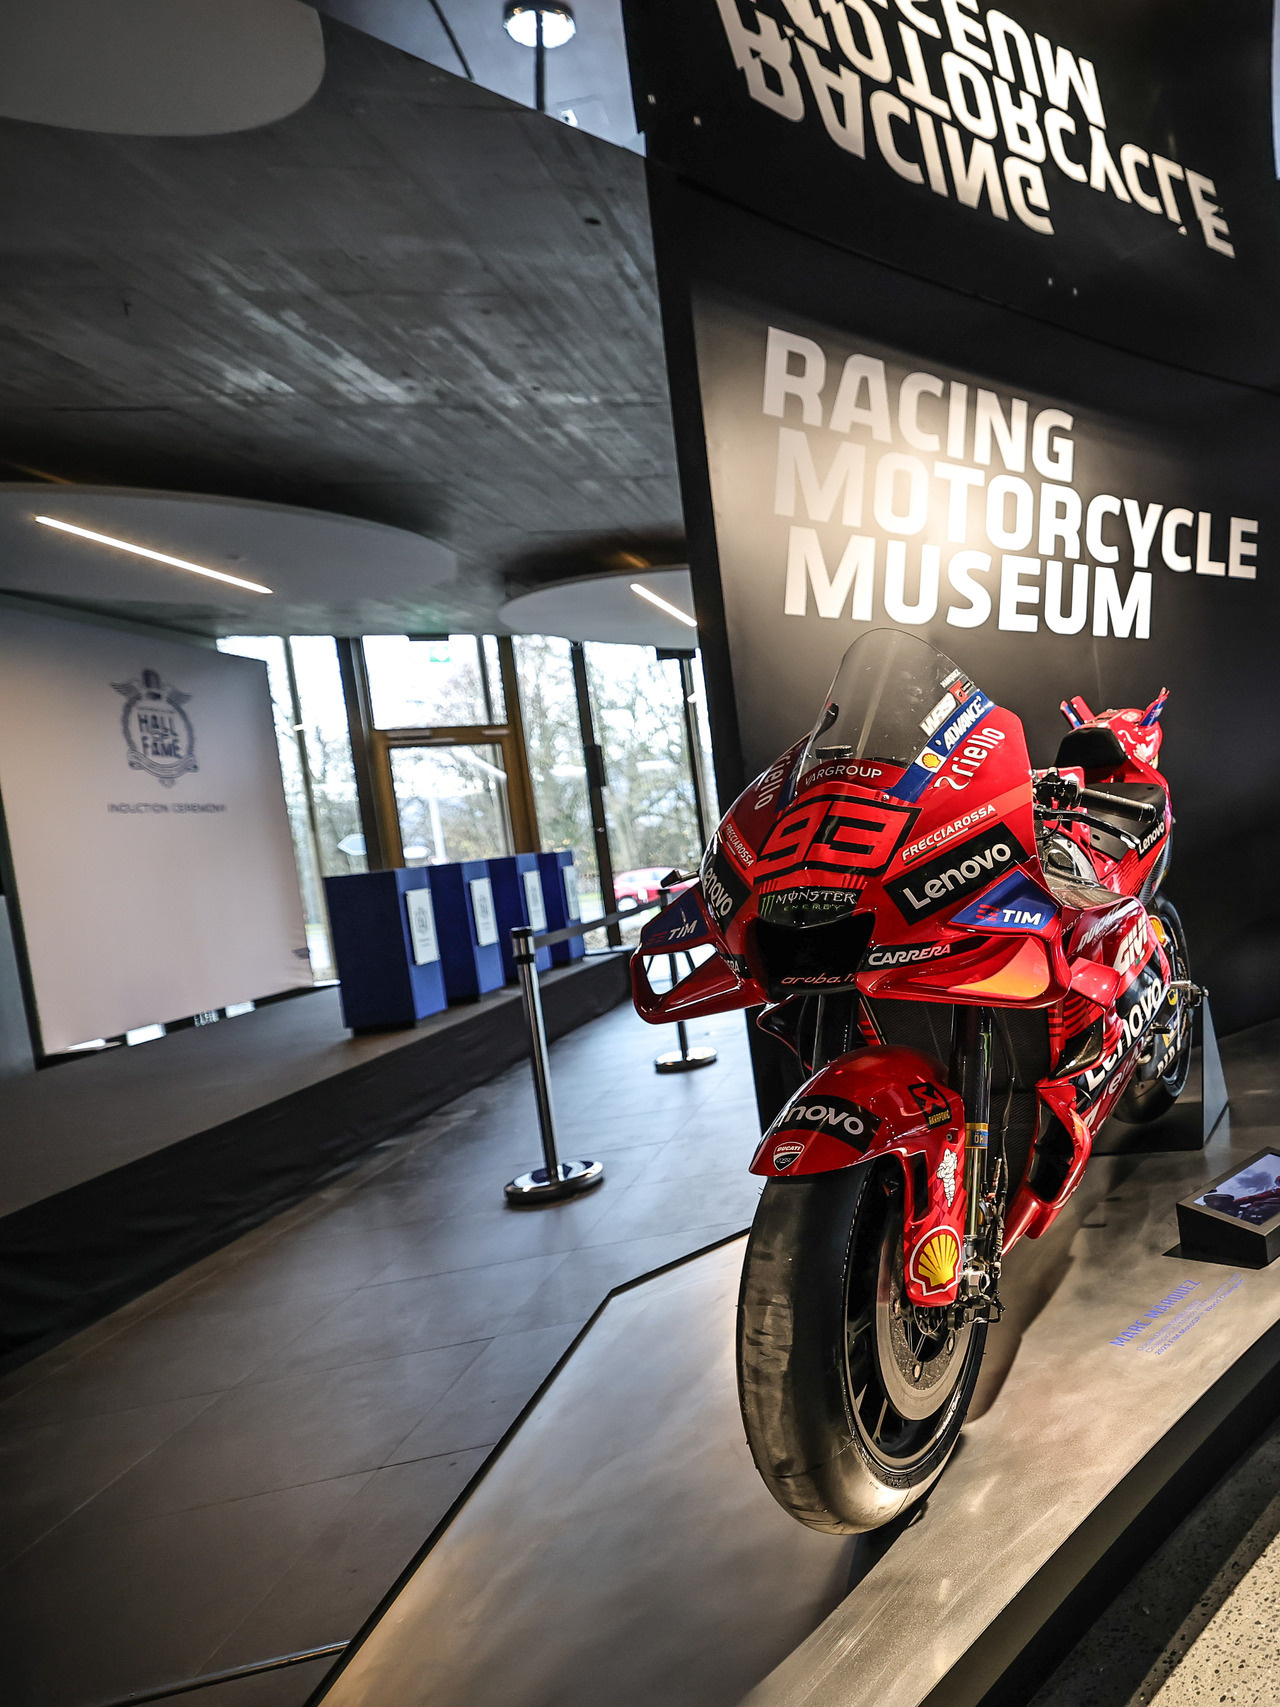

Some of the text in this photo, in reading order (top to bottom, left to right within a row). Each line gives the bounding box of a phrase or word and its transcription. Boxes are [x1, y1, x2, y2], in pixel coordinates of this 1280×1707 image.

[762, 326, 1075, 484] RACING
[773, 427, 1259, 580] MOTORCYCLE
[784, 526, 1153, 640] MUSEUM
[943, 699, 986, 752] ADVANCE
[951, 727, 1006, 778] riello
[725, 823, 755, 869] FRECCIAROSSA
[754, 799, 911, 879] 93
[901, 804, 996, 861] FRECCIAROSSA
[1138, 820, 1165, 854] Lenovo
[902, 843, 1012, 910] Lenovo
[668, 920, 698, 940] TIM
[1002, 909, 1042, 926] TIM
[867, 943, 951, 966] CARRERA
[1112, 914, 1148, 976] GIVI
[1084, 977, 1162, 1092] Lenovo
[777, 1104, 864, 1135] novo
[1109, 1319, 1152, 1347] MARC
[1168, 1335, 1181, 1343] FIM
